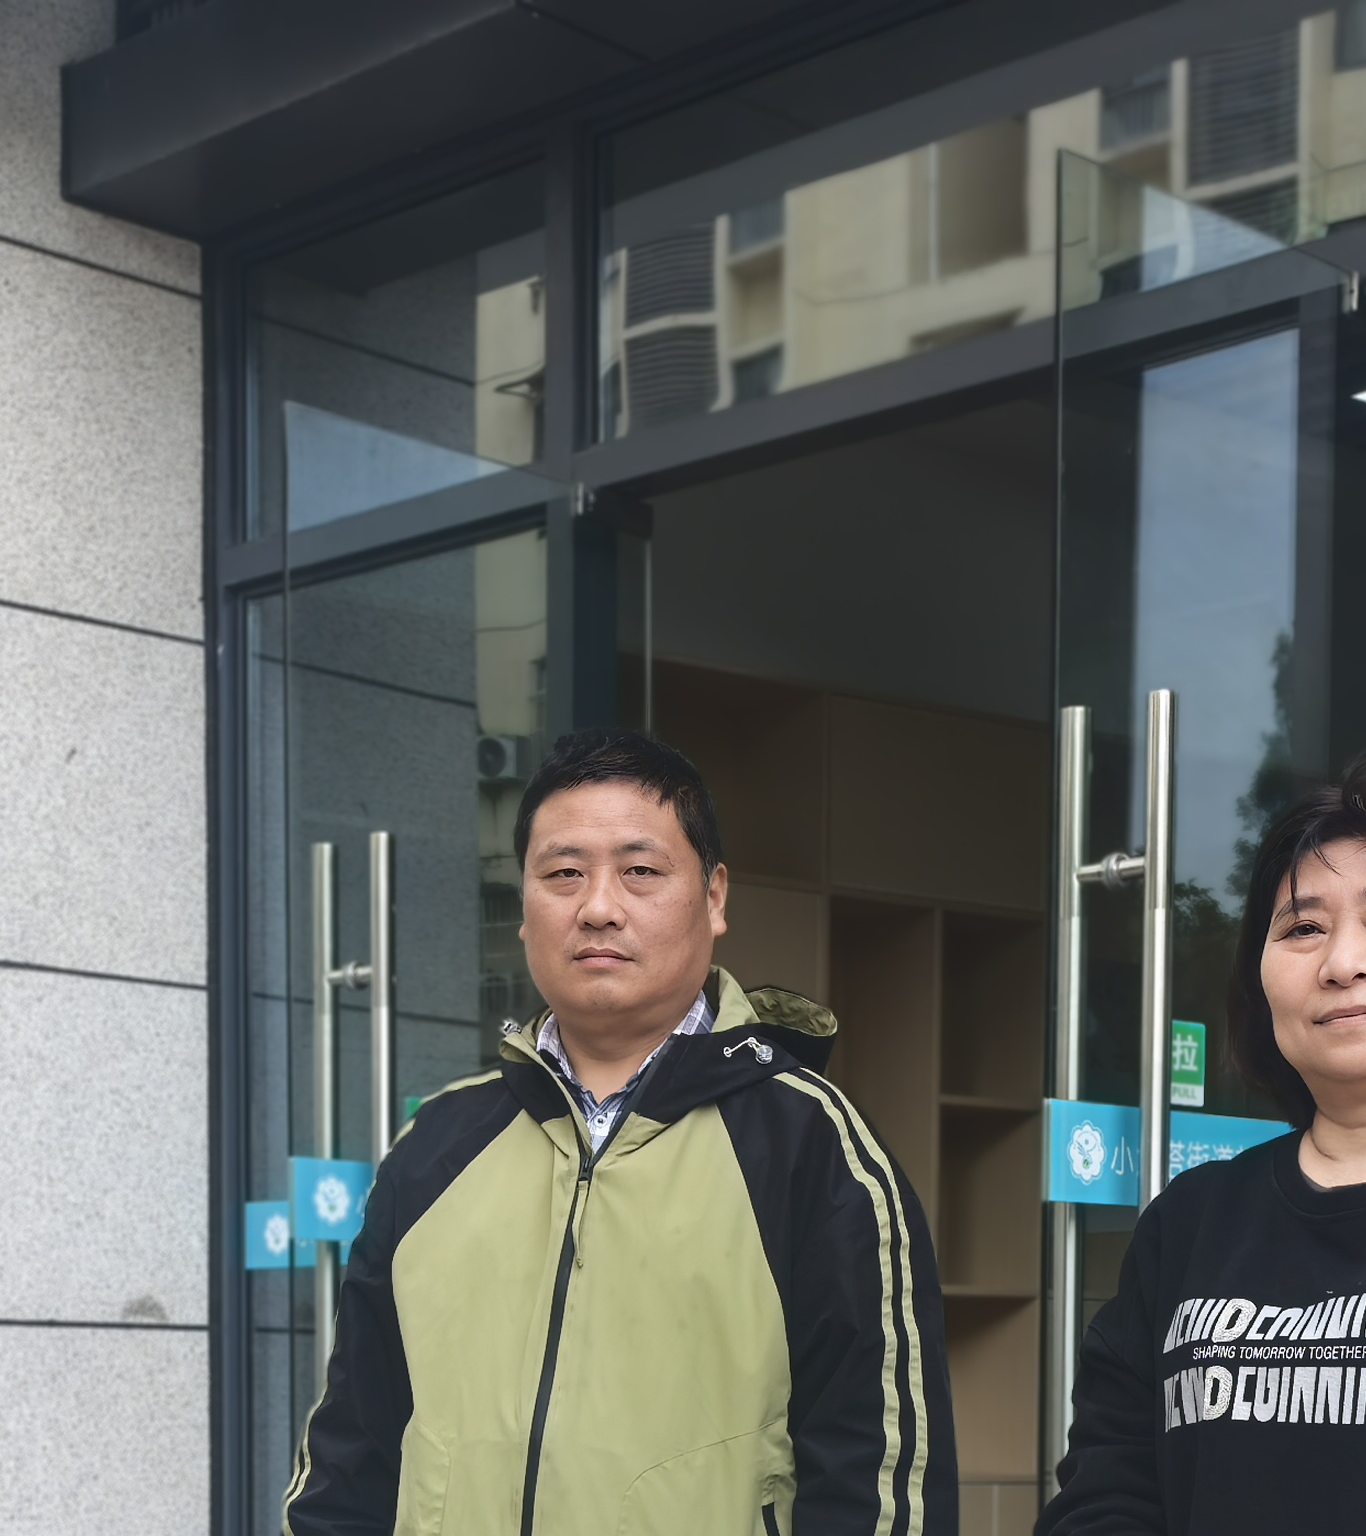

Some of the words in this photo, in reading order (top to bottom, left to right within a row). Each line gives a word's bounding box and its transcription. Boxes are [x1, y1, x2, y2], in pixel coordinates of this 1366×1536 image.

[1172, 1033, 1199, 1071] 拉
[1192, 1345, 1236, 1360] SHAPING
[1239, 1346, 1306, 1360] TOMORROW
